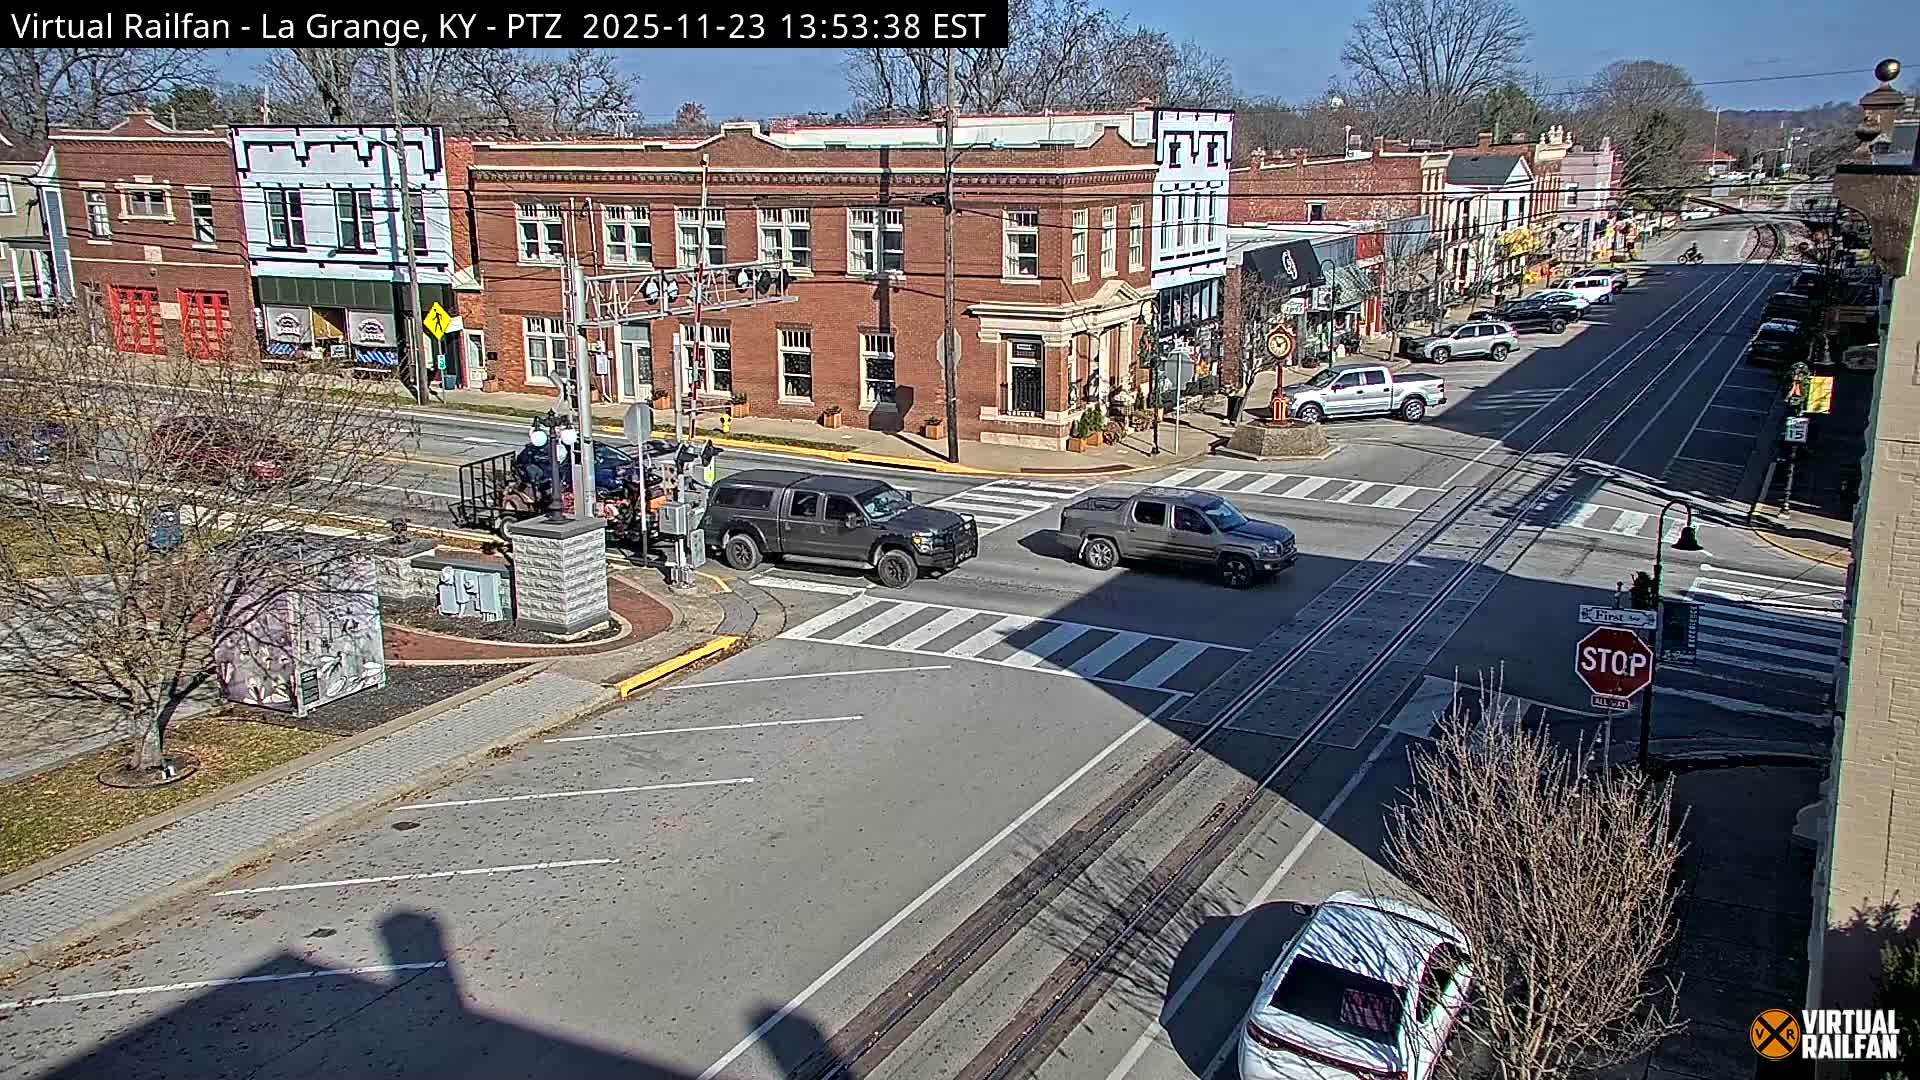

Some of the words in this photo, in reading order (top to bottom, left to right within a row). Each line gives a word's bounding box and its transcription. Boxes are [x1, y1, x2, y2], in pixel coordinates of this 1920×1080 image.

[1789, 429, 1805, 440] 15
[1594, 609, 1624, 622] First
[1580, 646, 1647, 677] STOP
[1594, 697, 1609, 706] ALL
[1609, 699, 1626, 708] WAY
